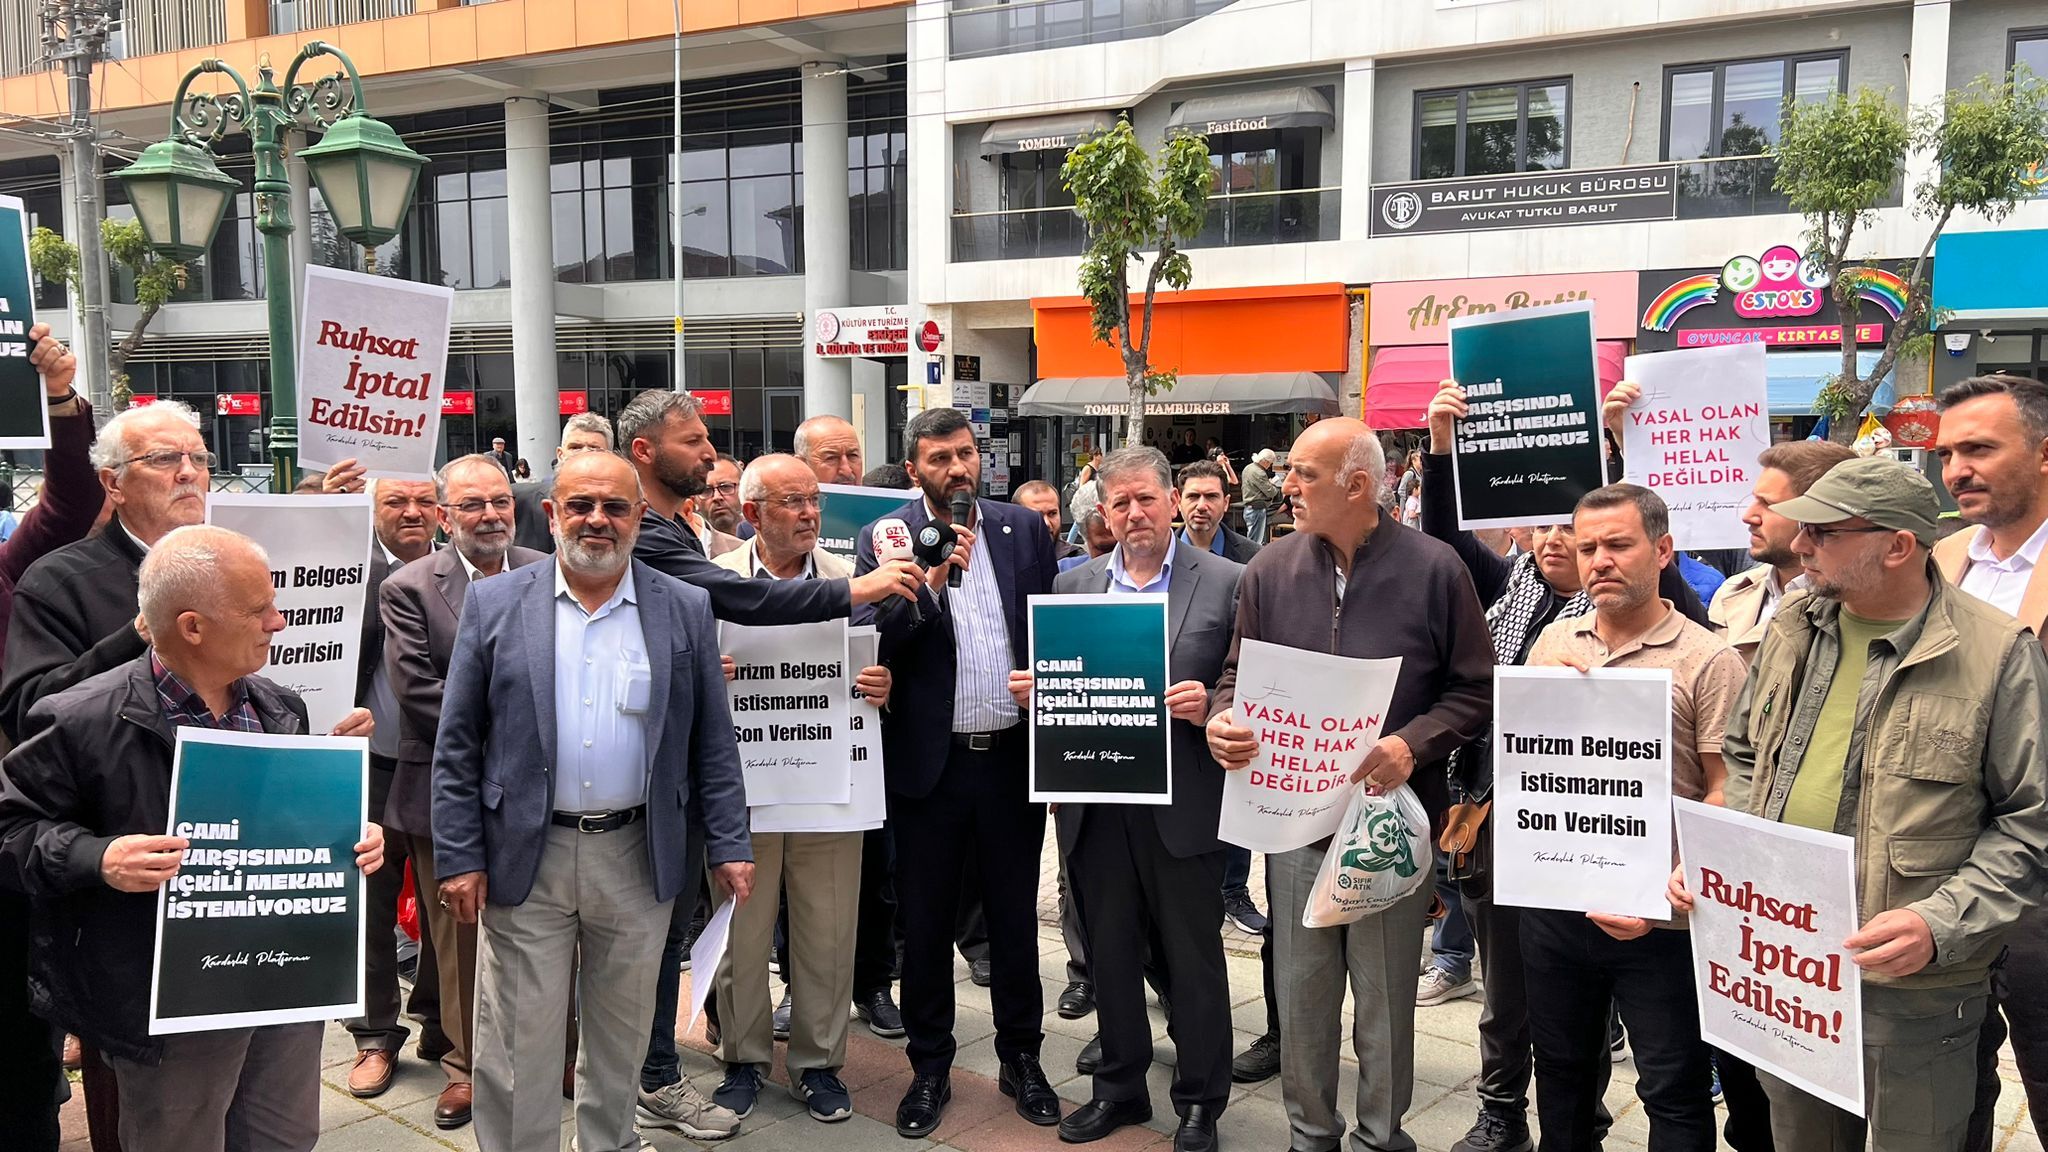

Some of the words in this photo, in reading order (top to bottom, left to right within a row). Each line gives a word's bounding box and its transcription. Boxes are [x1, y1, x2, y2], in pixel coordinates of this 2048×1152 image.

[1206, 117, 1268, 134] Fastfood
[1018, 136, 1067, 152] TOMBUL
[1431, 188, 1497, 204] BARUT
[1503, 182, 1572, 199] HUKUK
[1579, 176, 1668, 194] BÜROSU
[1460, 209, 1513, 222] AVUKAT
[1516, 207, 1563, 218] TUTKU
[1568, 203, 1618, 215] BARUT
[1742, 290, 1814, 309] ESTOYS
[842, 319, 867, 328] KÜLTÜR
[868, 319, 876, 327] VE
[878, 317, 903, 326] TURİZM
[316, 320, 419, 360] Ruhsat
[867, 327, 908, 341] ESKİŞEHİ
[1777, 327, 1870, 343] KIRTASE
[826, 341, 861, 355] KÜLTÜR
[343, 354, 431, 401] İptal
[1084, 404, 1129, 415] TOMBU
[1144, 402, 1230, 415] HAMBURGER
[1468, 394, 1573, 416] ARŞISINDA
[1631, 408, 1693, 426] YASAL
[1701, 402, 1759, 420] OLAN
[308, 397, 426, 437] Edilsin!
[1457, 414, 1511, 438] İÇKİLİ
[1513, 411, 1586, 431] MEKAN
[1458, 430, 1589, 454] İSTEMİYORUZ
[1651, 429, 1691, 445] HER
[1699, 425, 1741, 442] HAK
[1664, 448, 1730, 465] HELAL
[1648, 466, 1749, 487] DEĞİLDİR.
[885, 527, 904, 535] GZT
[892, 538, 906, 548] 26
[293, 563, 363, 589] Belgesi
[280, 605, 344, 627] marına
[269, 641, 343, 666] Verilsin
[1036, 656, 1083, 672] CAMİ
[780, 660, 842, 681] Belgesi
[1036, 677, 1146, 694] KARŞISINDA
[733, 694, 829, 712] istismarına
[1037, 692, 1088, 712] İÇKİLİ
[1090, 695, 1156, 709] MEKAN
[1036, 710, 1158, 727] İSTEMİYORUZ
[1243, 701, 1311, 730] YASAL
[1321, 713, 1380, 732] OLAN
[734, 725, 763, 744] Son
[769, 723, 832, 743] Verilsin
[1261, 728, 1305, 751] HER
[1314, 737, 1358, 753] HAK
[1503, 733, 1574, 756] Turizm
[1581, 736, 1662, 760] Belgesi
[1271, 752, 1340, 773] HELAL
[1250, 770, 1348, 794] DEĞİLDİR.
[1521, 771, 1643, 798] istismarına
[176, 818, 239, 841] CAMİ
[1517, 808, 1557, 831] Son
[1564, 811, 1647, 837] Verilsin
[169, 869, 243, 897] İÇKİLİ
[245, 871, 345, 892] MEKAN
[167, 895, 347, 920] İSTEMİYORUZ
[1700, 866, 1818, 933] Ruhsat
[1738, 916, 1842, 992] İptal
[1708, 960, 1843, 1044] Edilsin!
